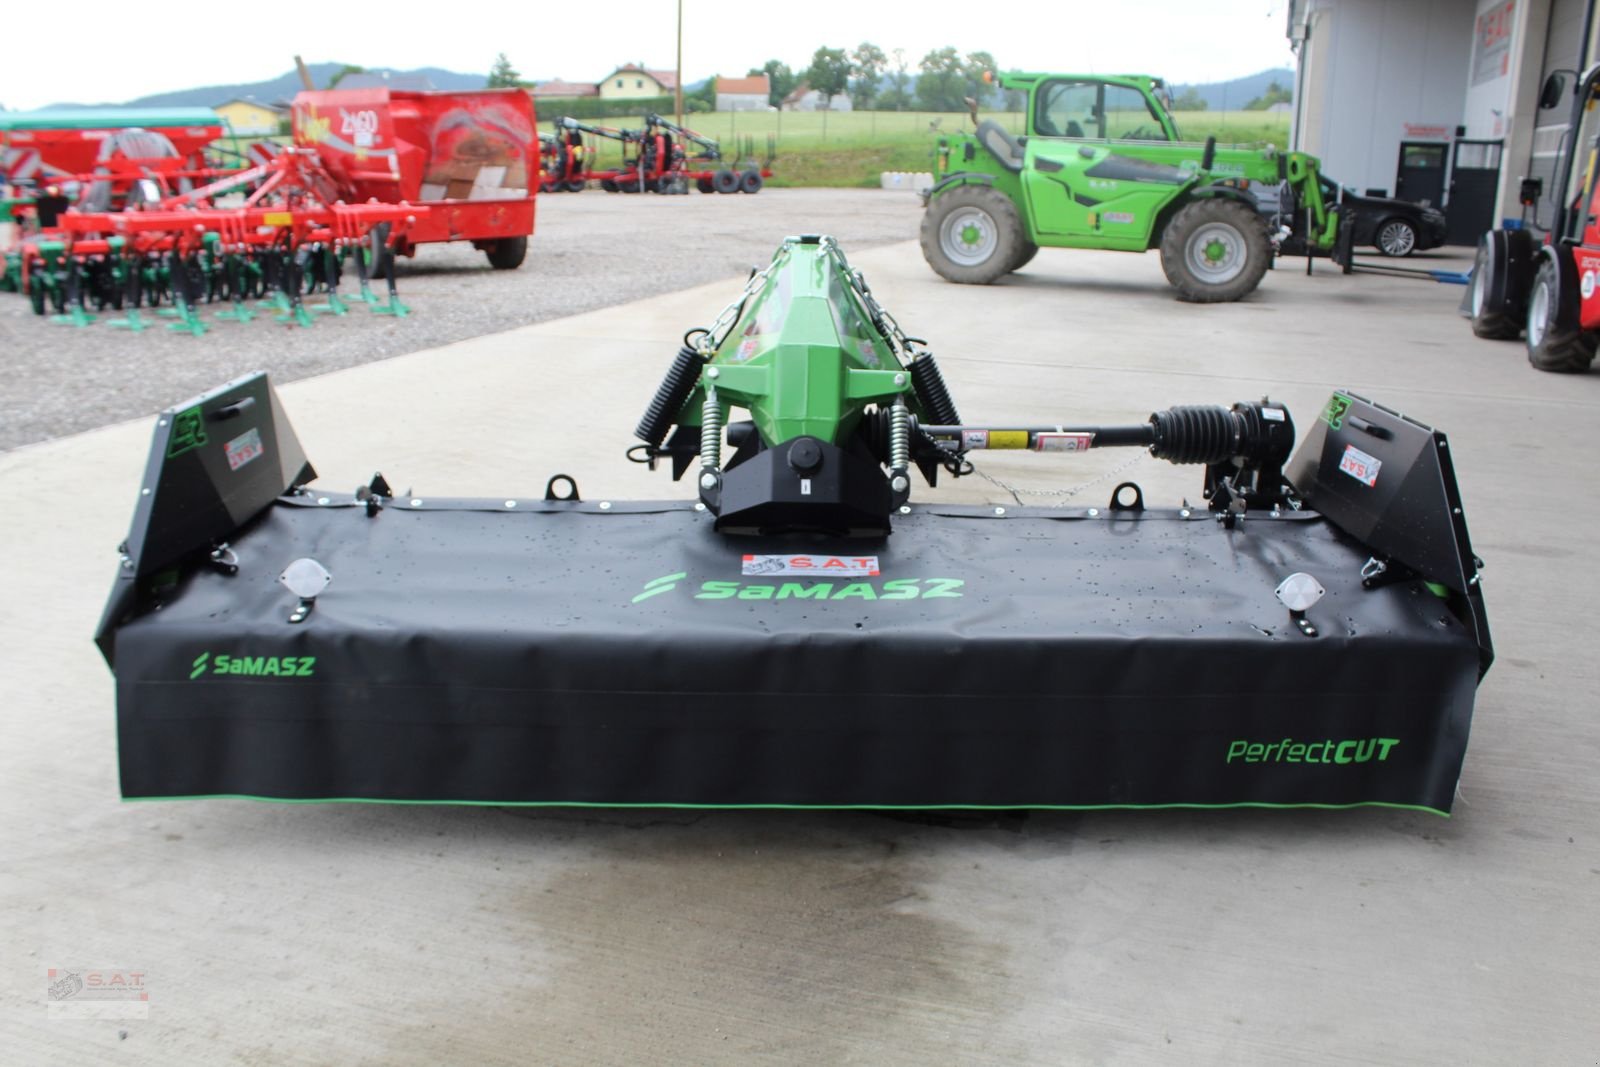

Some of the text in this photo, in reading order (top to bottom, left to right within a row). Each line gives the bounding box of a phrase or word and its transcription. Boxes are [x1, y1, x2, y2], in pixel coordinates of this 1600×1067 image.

[789, 556, 874, 568] S.A.T.
[694, 578, 965, 601] SaMASZ
[212, 655, 316, 676] SaMASZ
